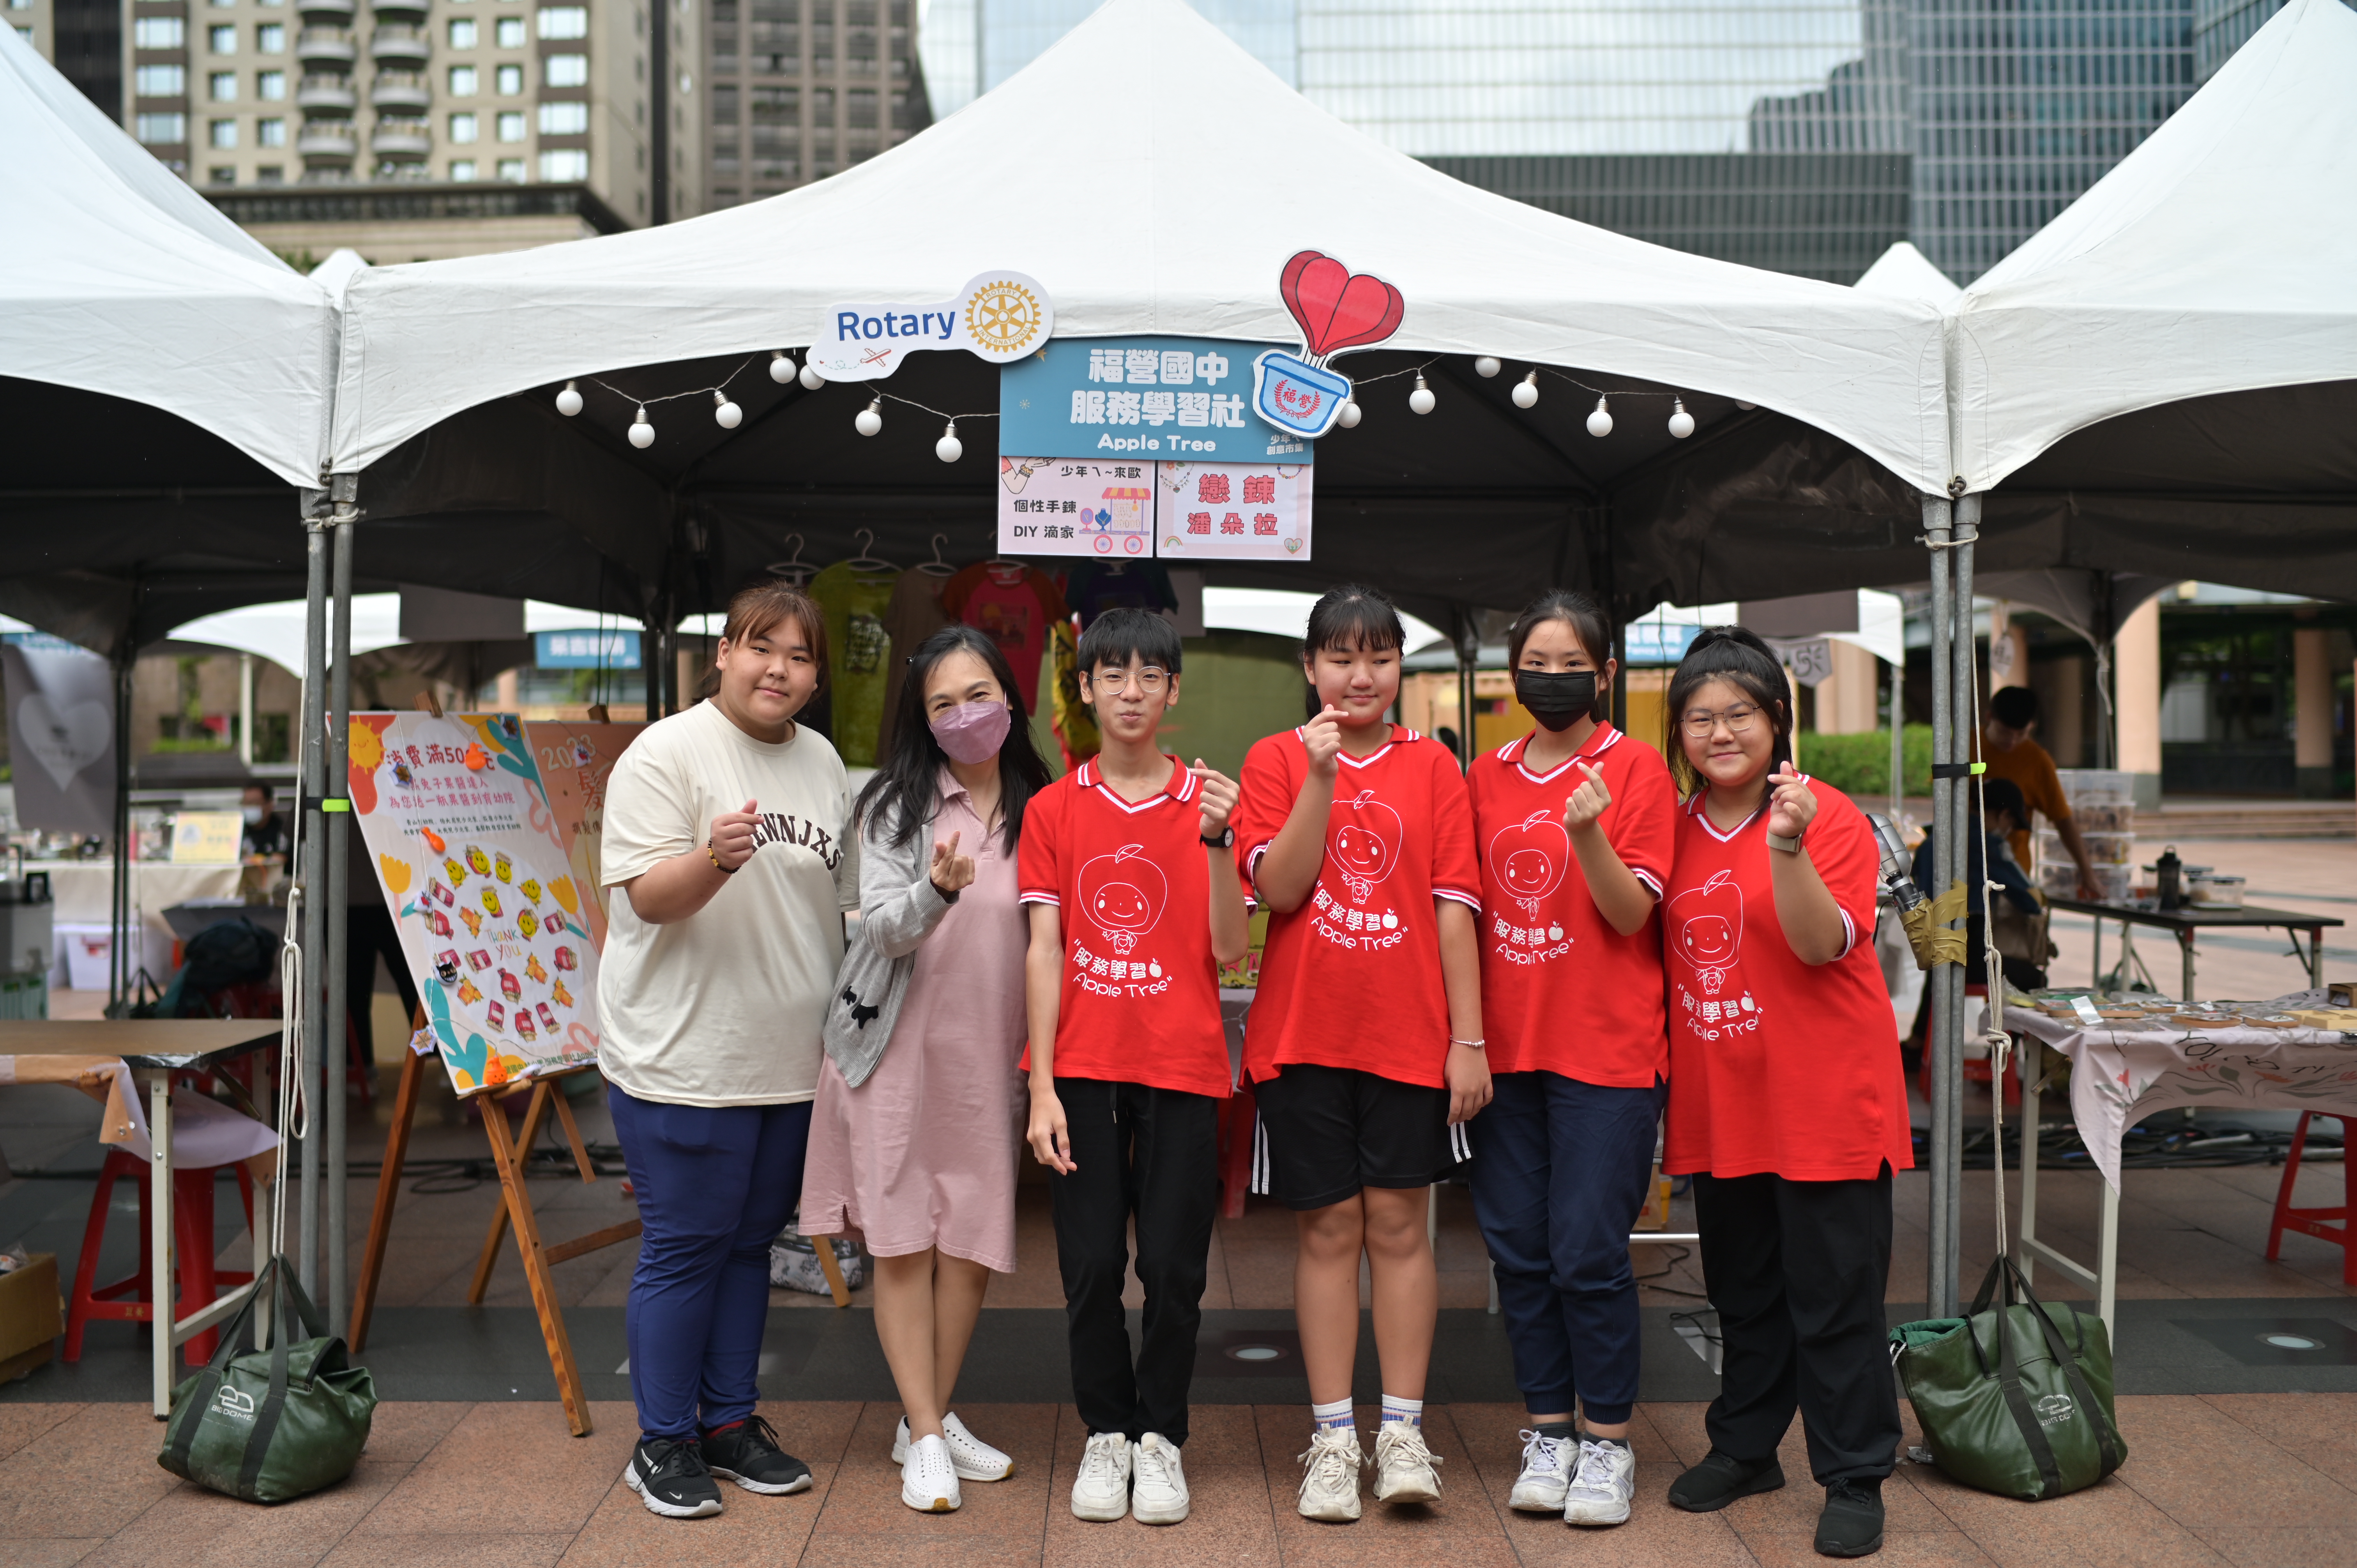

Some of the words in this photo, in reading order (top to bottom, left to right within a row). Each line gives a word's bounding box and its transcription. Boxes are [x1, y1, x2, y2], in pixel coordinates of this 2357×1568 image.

[986, 289, 1016, 298] ROTARY
[837, 311, 956, 341] Rotary
[979, 326, 1030, 345] INTERNATIONAL
[1088, 349, 1228, 386] 福營國中
[1070, 390, 1246, 428] 服務學習社
[1097, 433, 1159, 451] Apple
[1166, 435, 1216, 452] Tree
[1266, 443, 1304, 455] 創意市集
[1013, 499, 1077, 514] 個性手鍊
[1014, 526, 1038, 537] DIY
[1044, 525, 1074, 539] 滴家
[1187, 512, 1278, 536] 潘朵拉
[751, 813, 841, 871] EWNJXS
[1311, 916, 1356, 949] Apple
[1073, 972, 1122, 998] Apple
[211, 1404, 223, 1413] BIG
[223, 1408, 254, 1421] DOME
